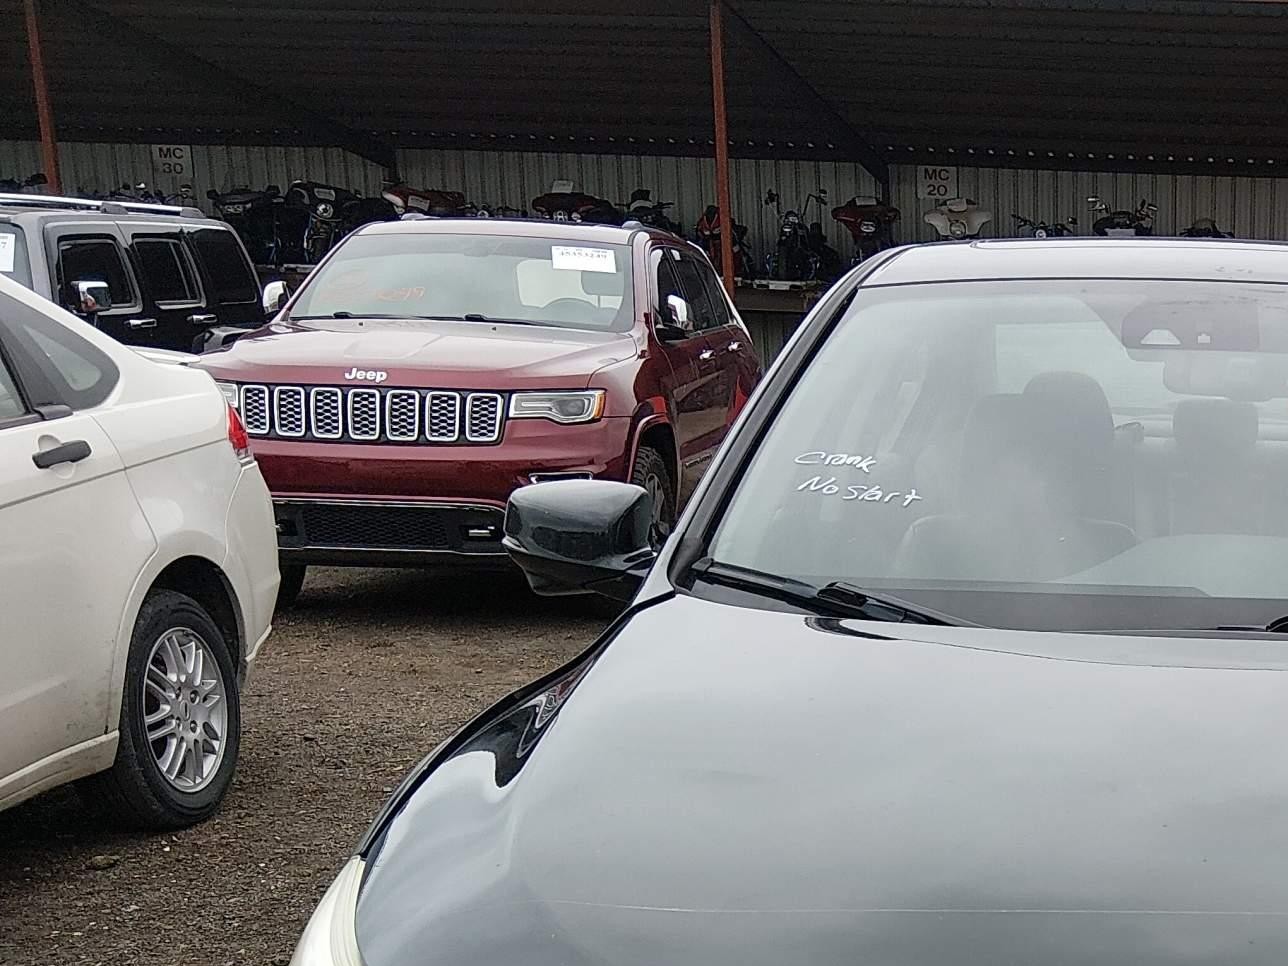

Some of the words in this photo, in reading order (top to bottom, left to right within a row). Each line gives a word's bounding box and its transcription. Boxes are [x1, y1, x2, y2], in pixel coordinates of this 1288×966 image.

[158, 147, 184, 159] MC
[162, 162, 184, 174] 30
[924, 167, 950, 180] MC
[927, 184, 948, 196] 20
[344, 367, 388, 383] Jeep
[794, 451, 877, 473] Crank
[797, 476, 840, 494] No
